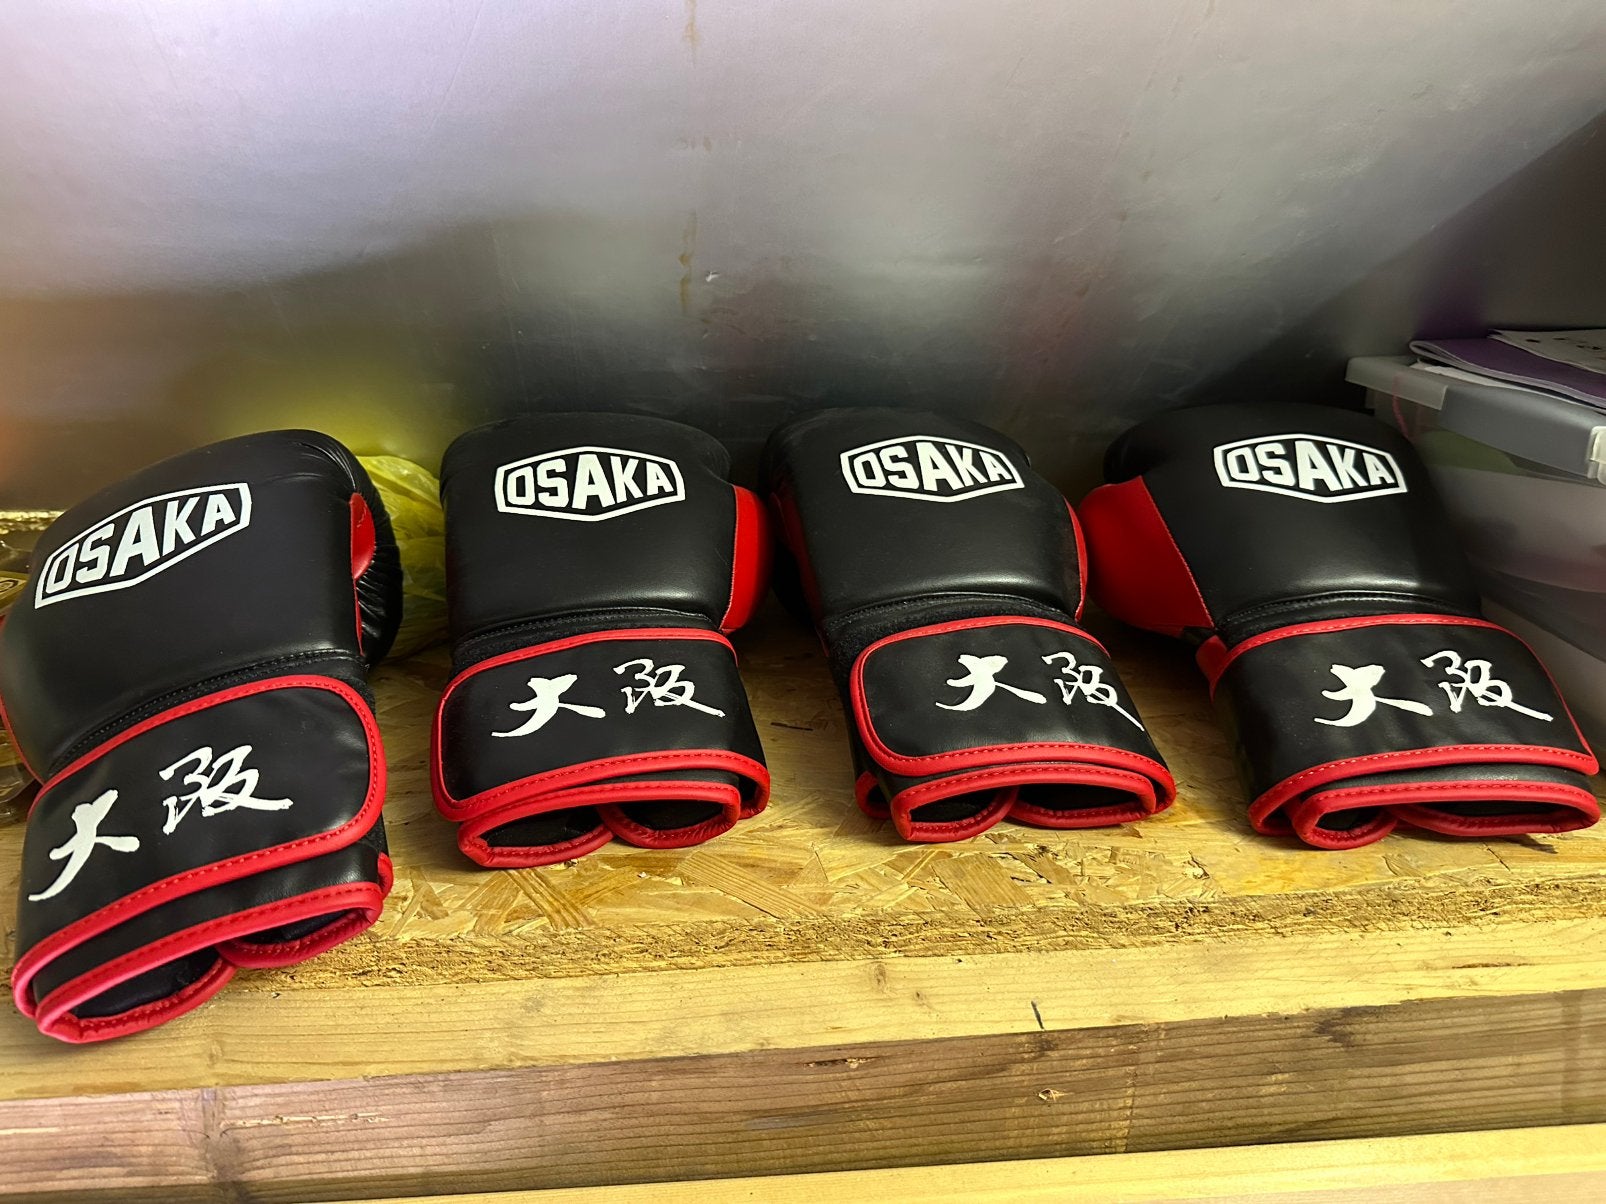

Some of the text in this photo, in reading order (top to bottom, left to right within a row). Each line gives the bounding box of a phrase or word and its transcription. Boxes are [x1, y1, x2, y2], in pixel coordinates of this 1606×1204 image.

[506, 453, 675, 510] OSAKA
[853, 441, 1013, 492] OSAKA
[1226, 440, 1396, 492] OSAKA
[45, 492, 237, 594] OSAKA
[491, 658, 726, 738] 大阪
[935, 651, 1146, 732] 大阪
[1314, 650, 1554, 728] 大阪
[28, 744, 294, 902] 大阪
